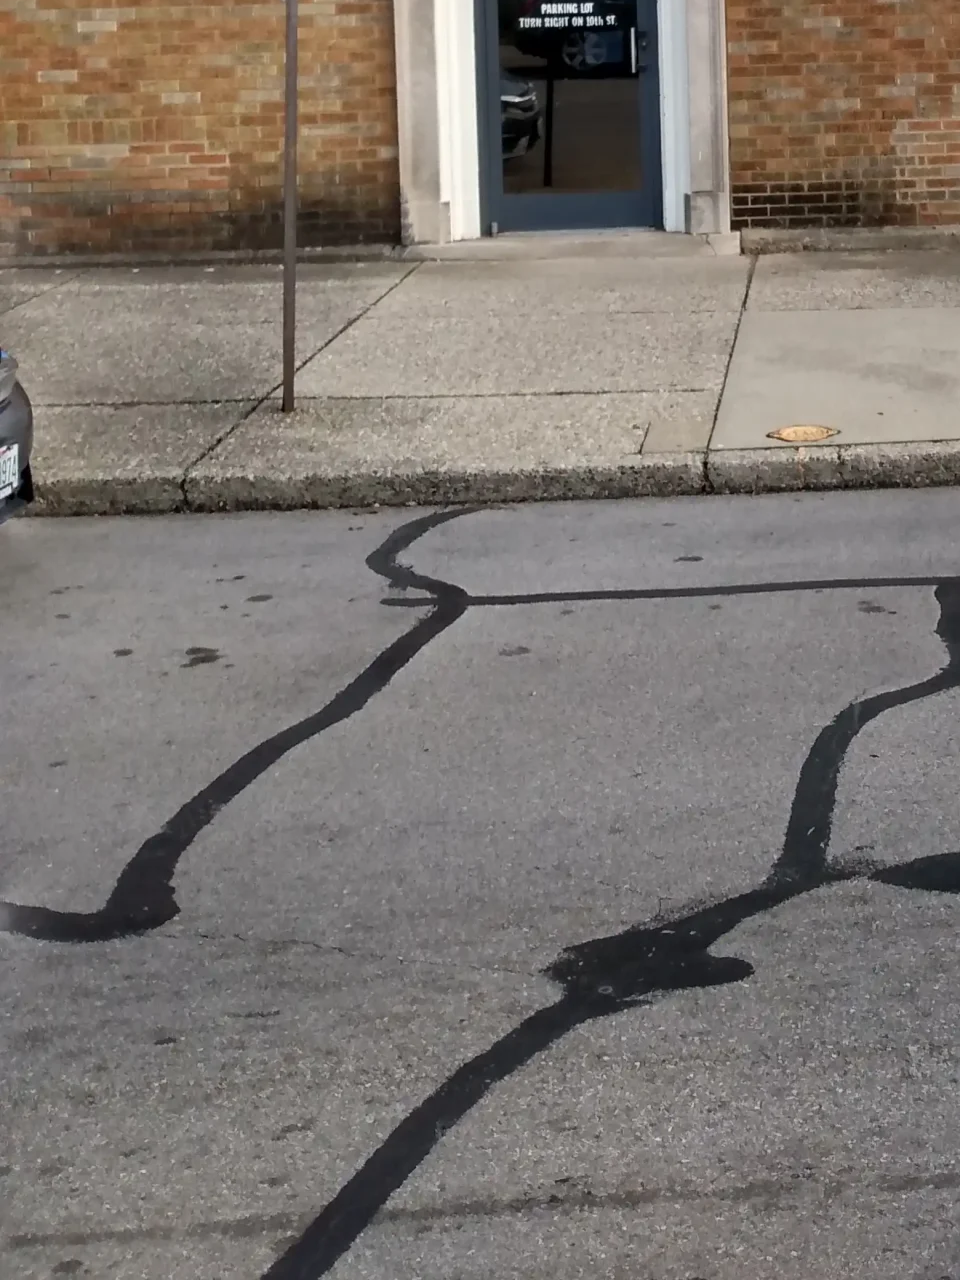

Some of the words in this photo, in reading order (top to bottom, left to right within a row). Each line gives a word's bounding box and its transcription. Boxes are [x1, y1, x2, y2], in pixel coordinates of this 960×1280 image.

[540, 2, 578, 15] PARKING
[580, 2, 594, 14] LOT
[518, 17, 542, 28] TURN
[544, 16, 569, 27] RIGHT
[571, 16, 584, 27] ON
[586, 15, 604, 27] 10th
[0, 455, 17, 485] 974
